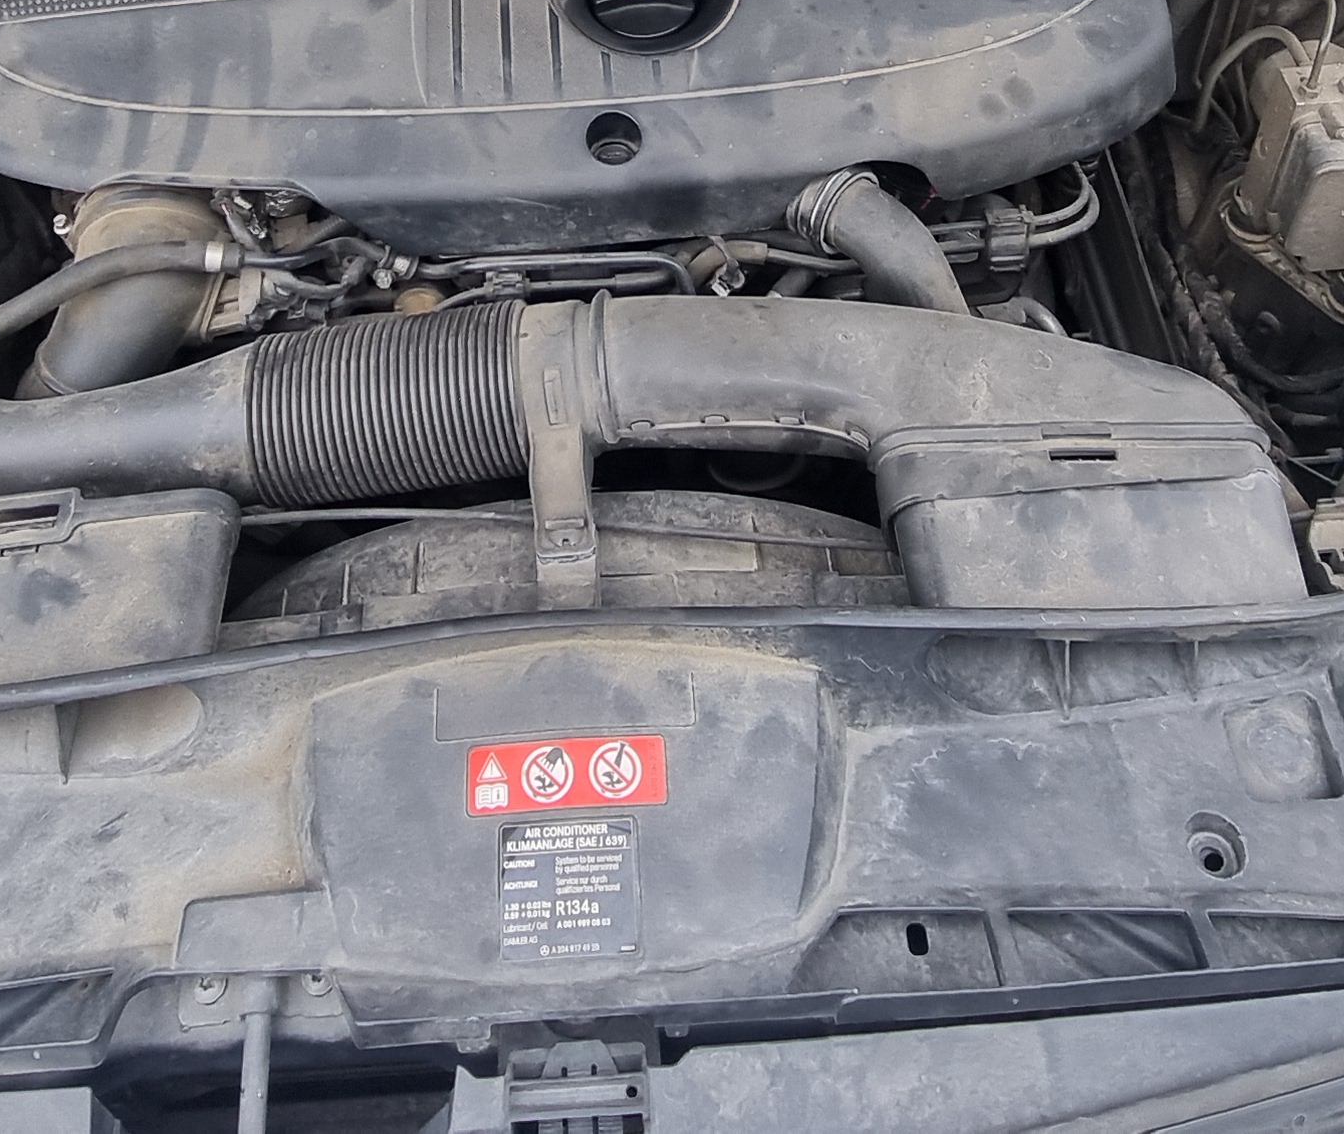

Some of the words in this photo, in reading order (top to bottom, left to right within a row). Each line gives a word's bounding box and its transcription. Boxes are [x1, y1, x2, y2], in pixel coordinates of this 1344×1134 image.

[524, 827, 541, 839] AIR
[543, 823, 608, 837] CONDITIONER
[506, 837, 574, 852] KLIMAANLAGE
[576, 836, 597, 850] (SAE
[599, 837, 604, 847] J
[605, 835, 627, 848] 639)
[555, 856, 579, 866] System
[579, 855, 587, 864] to
[587, 855, 595, 864] be
[597, 853, 623, 863] serviced
[564, 864, 589, 874] qualified
[590, 862, 619, 873] personnel
[555, 877, 578, 886] Service
[590, 875, 608, 884] durch
[594, 883, 621, 893] Personal
[555, 899, 600, 916] R134a
